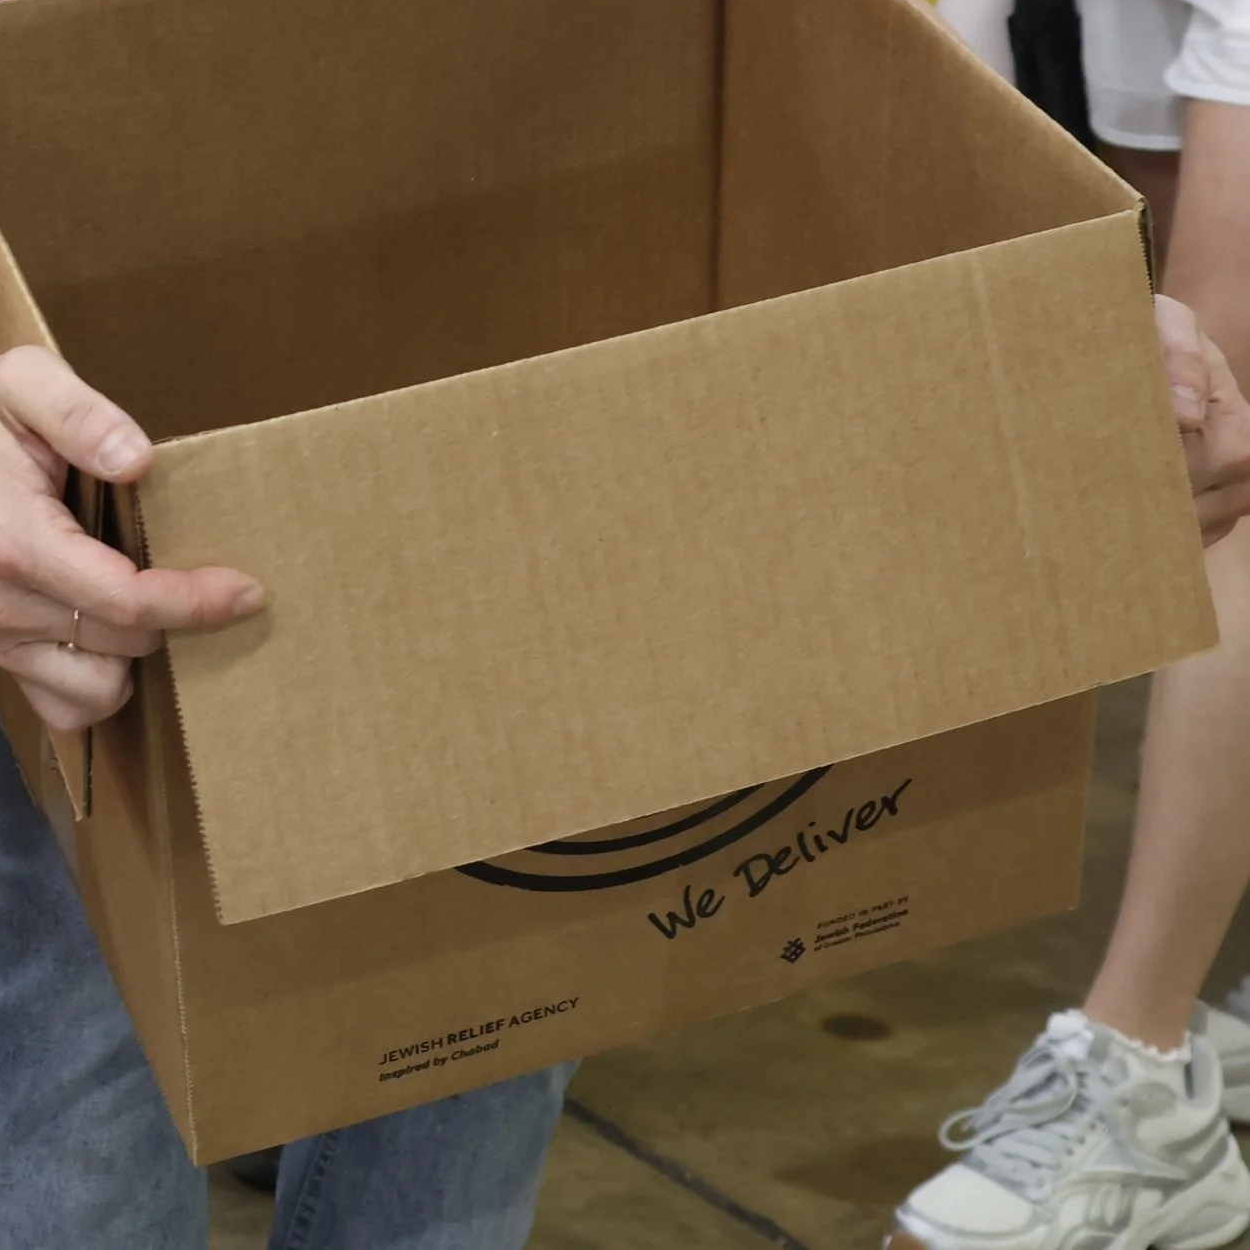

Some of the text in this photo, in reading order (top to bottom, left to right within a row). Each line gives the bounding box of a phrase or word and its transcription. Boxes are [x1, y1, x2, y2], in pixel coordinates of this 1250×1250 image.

[648, 778, 912, 939] We Deliver
[379, 997, 579, 1066] JEWISH RELIEF AGENCY
[433, 1054, 448, 1068] by
[451, 1039, 500, 1061] Chabad
